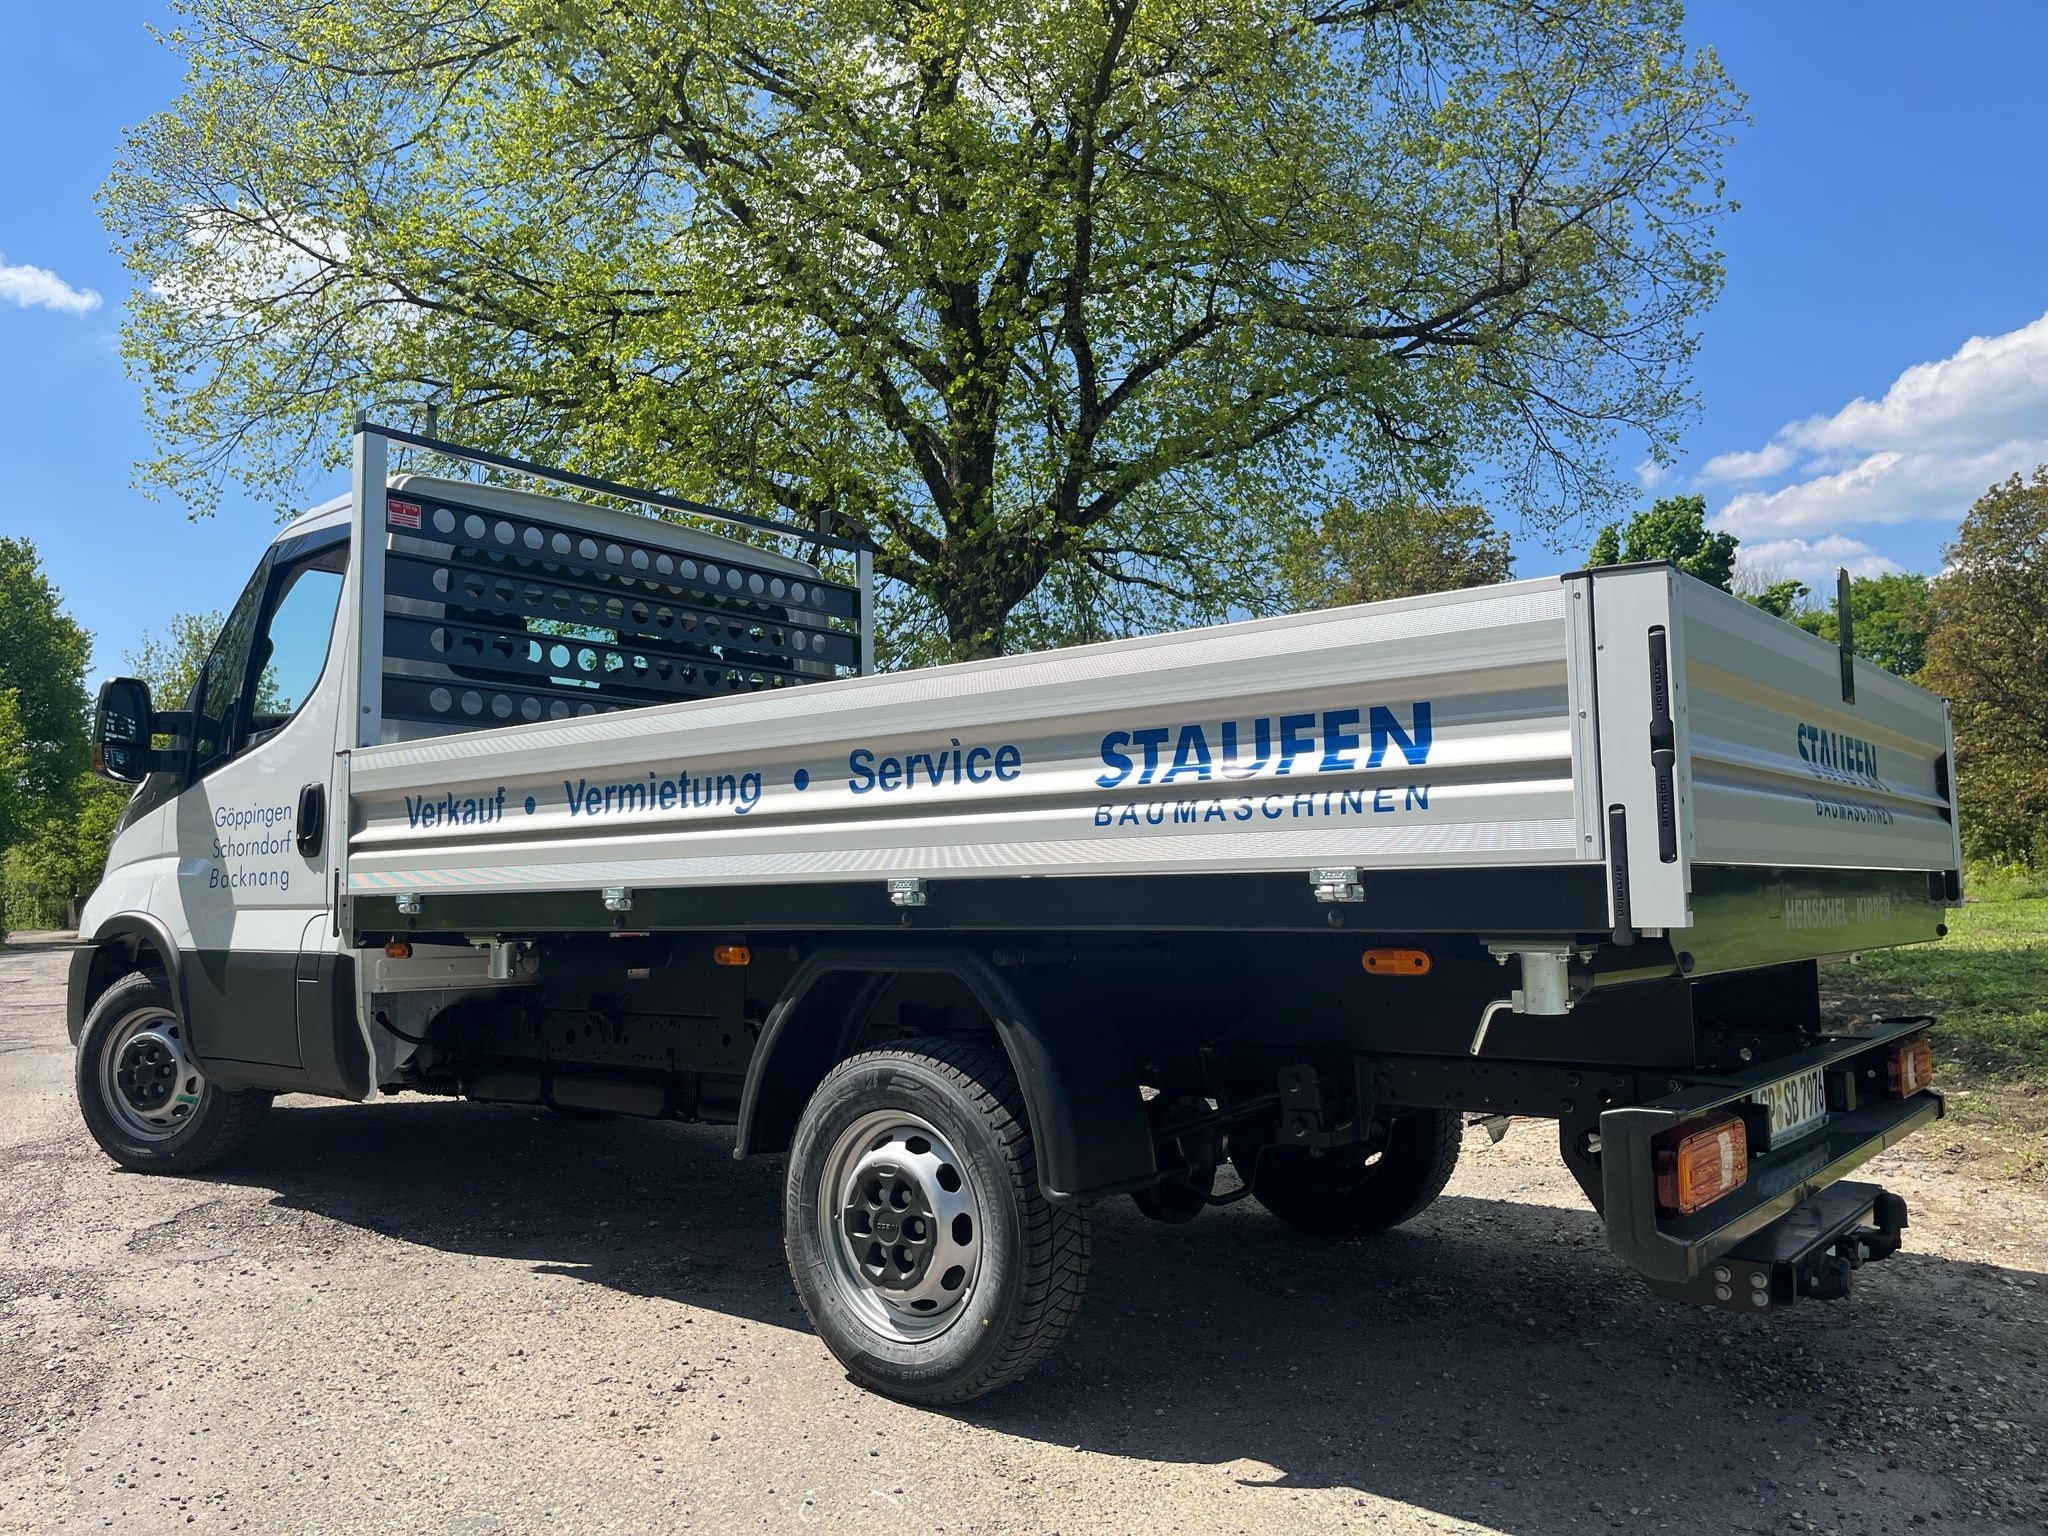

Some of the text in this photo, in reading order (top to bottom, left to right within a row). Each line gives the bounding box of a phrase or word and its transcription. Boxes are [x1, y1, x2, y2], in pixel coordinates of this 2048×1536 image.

[1095, 701, 1432, 788] STAUFEN
[405, 737, 1022, 829] Verkauf Vermietung Service
[215, 803, 292, 831] Göppingen
[1094, 783, 1431, 827] BAUMASCHINEN
[213, 830, 292, 859] Schorndorf
[209, 865, 289, 891] Backnang
[1785, 897, 1891, 930] HENSCHEL KIPPER
[1784, 1080, 1799, 1126] SB
